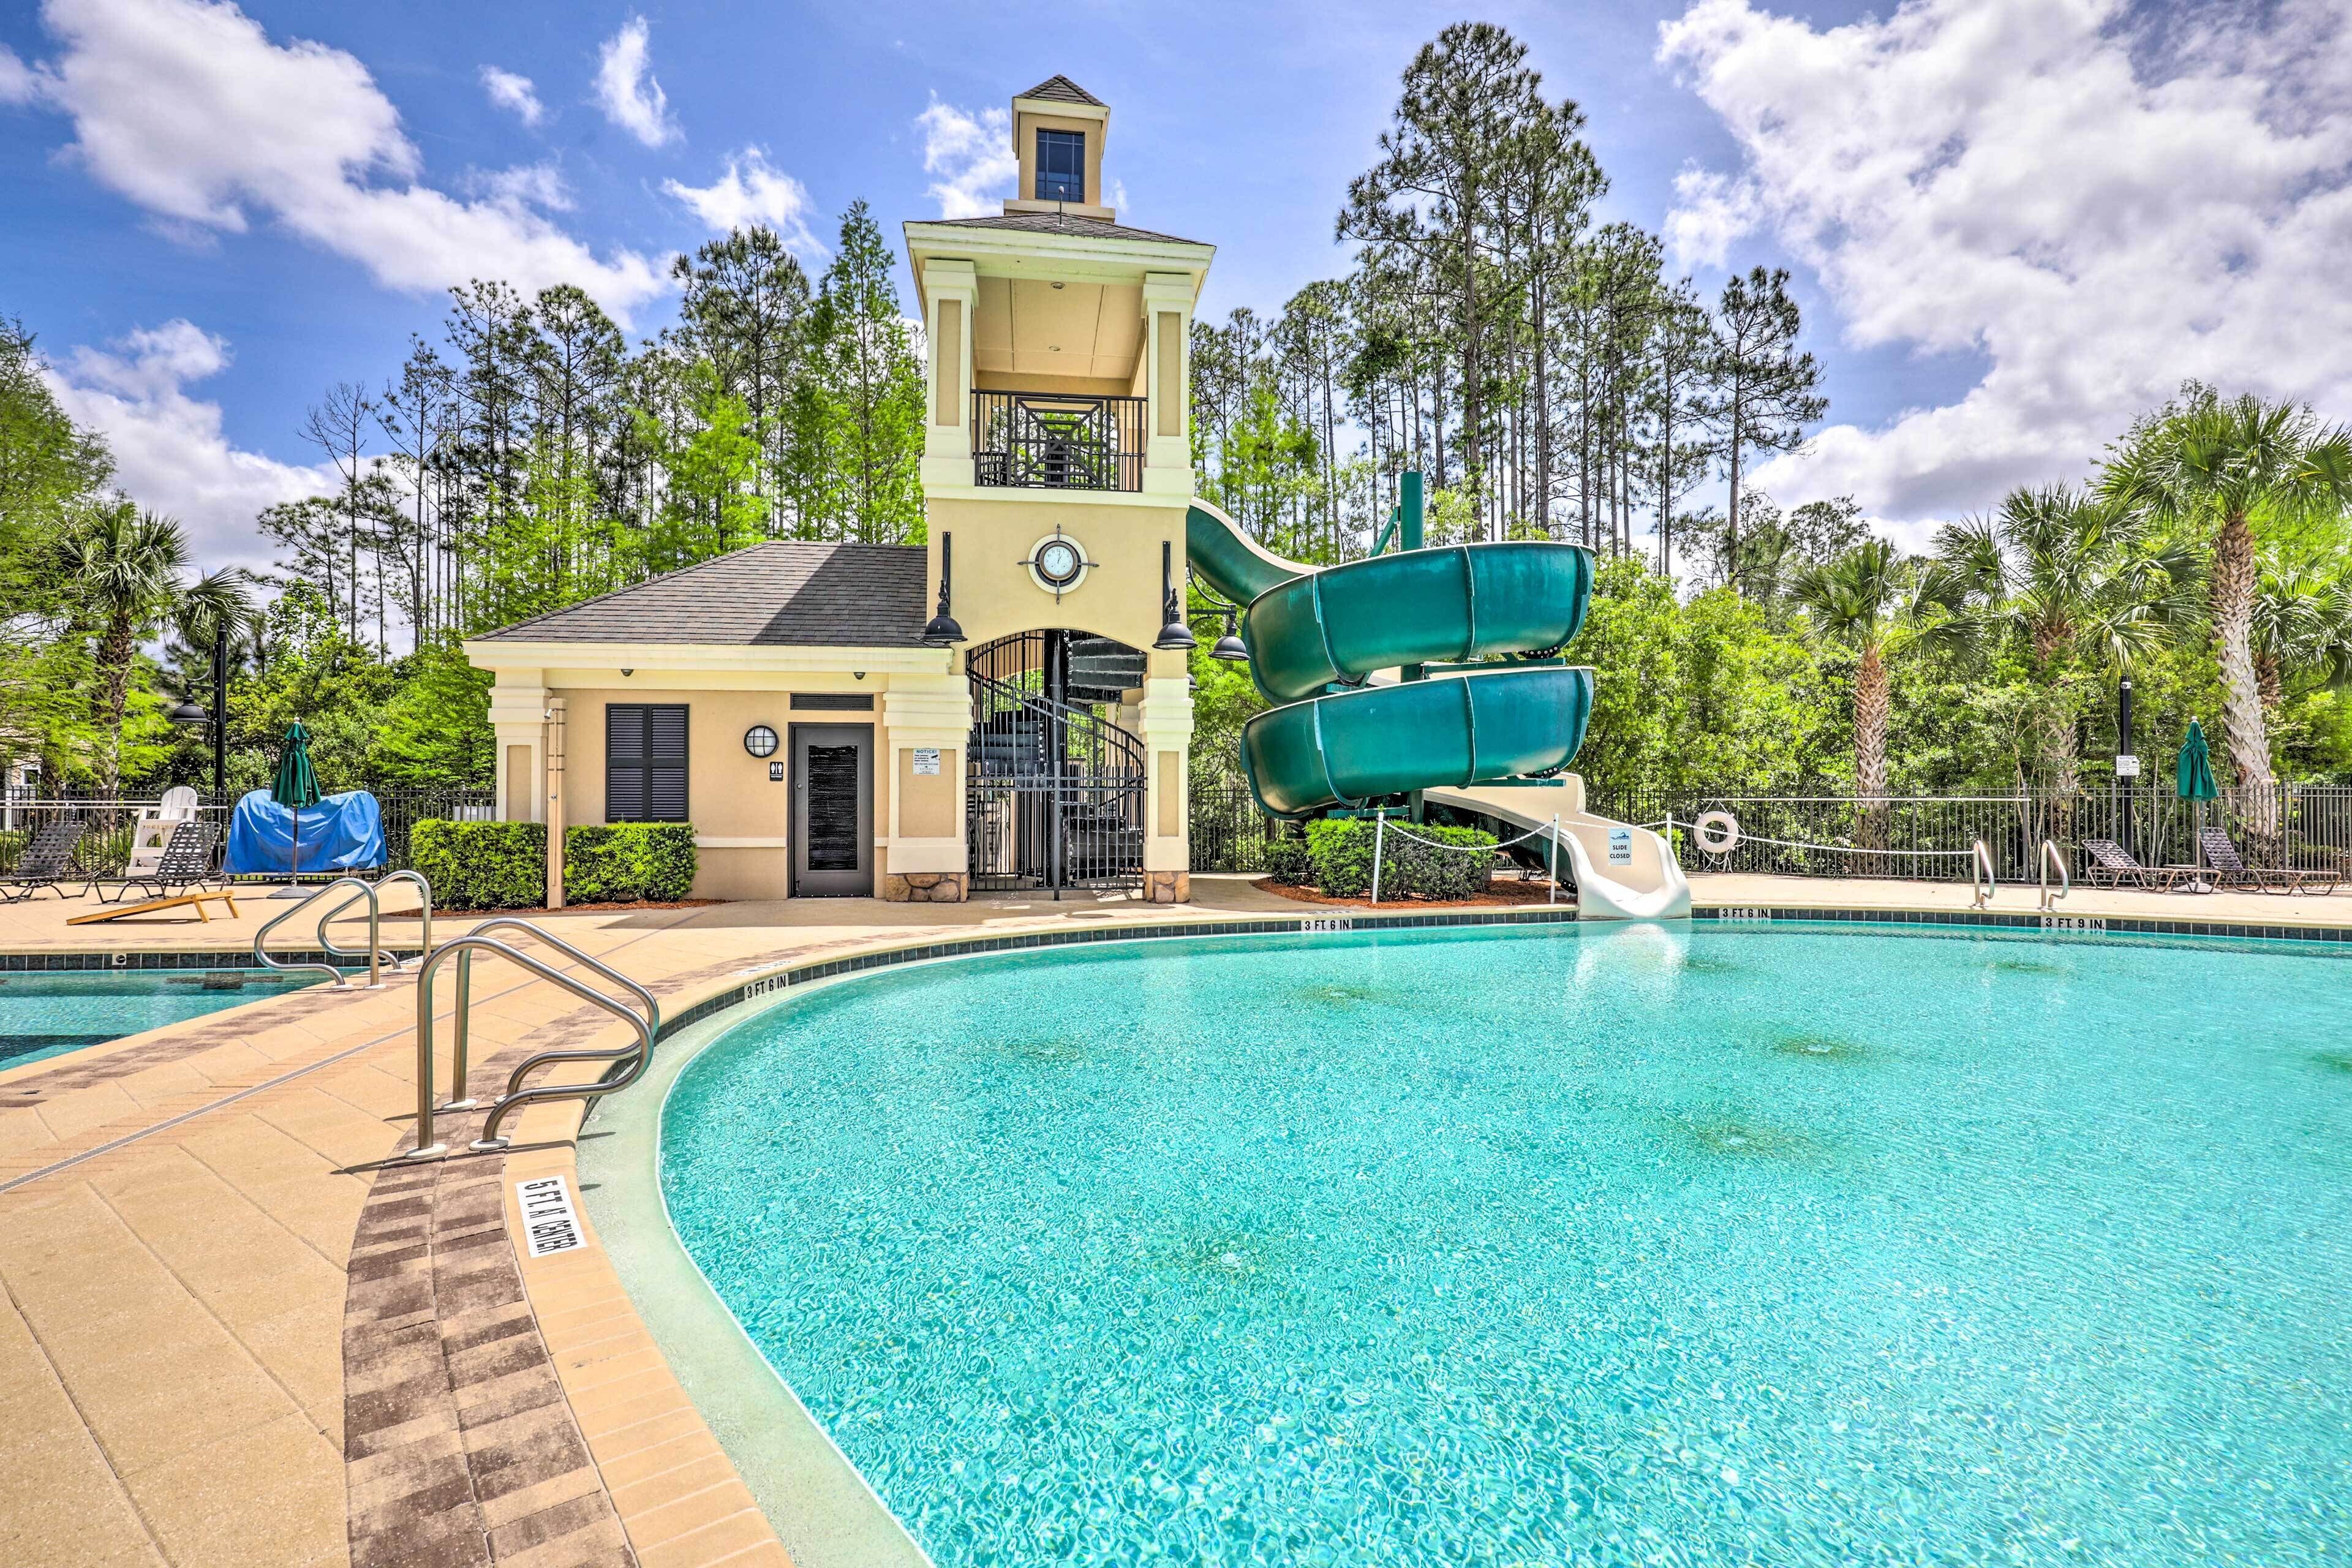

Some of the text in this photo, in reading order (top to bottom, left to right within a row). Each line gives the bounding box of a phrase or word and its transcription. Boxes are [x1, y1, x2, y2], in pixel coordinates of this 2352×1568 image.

[1722, 908, 1770, 918] 3 FT. 6 IN.
[1305, 919, 1351, 930] 3 FT. 6 IN.
[2045, 918, 2105, 929] 3 FT. 9 IN.
[747, 986, 753, 999] 3
[769, 979, 774, 992] 6
[524, 1180, 578, 1253] 5 FT. AT CENTER
